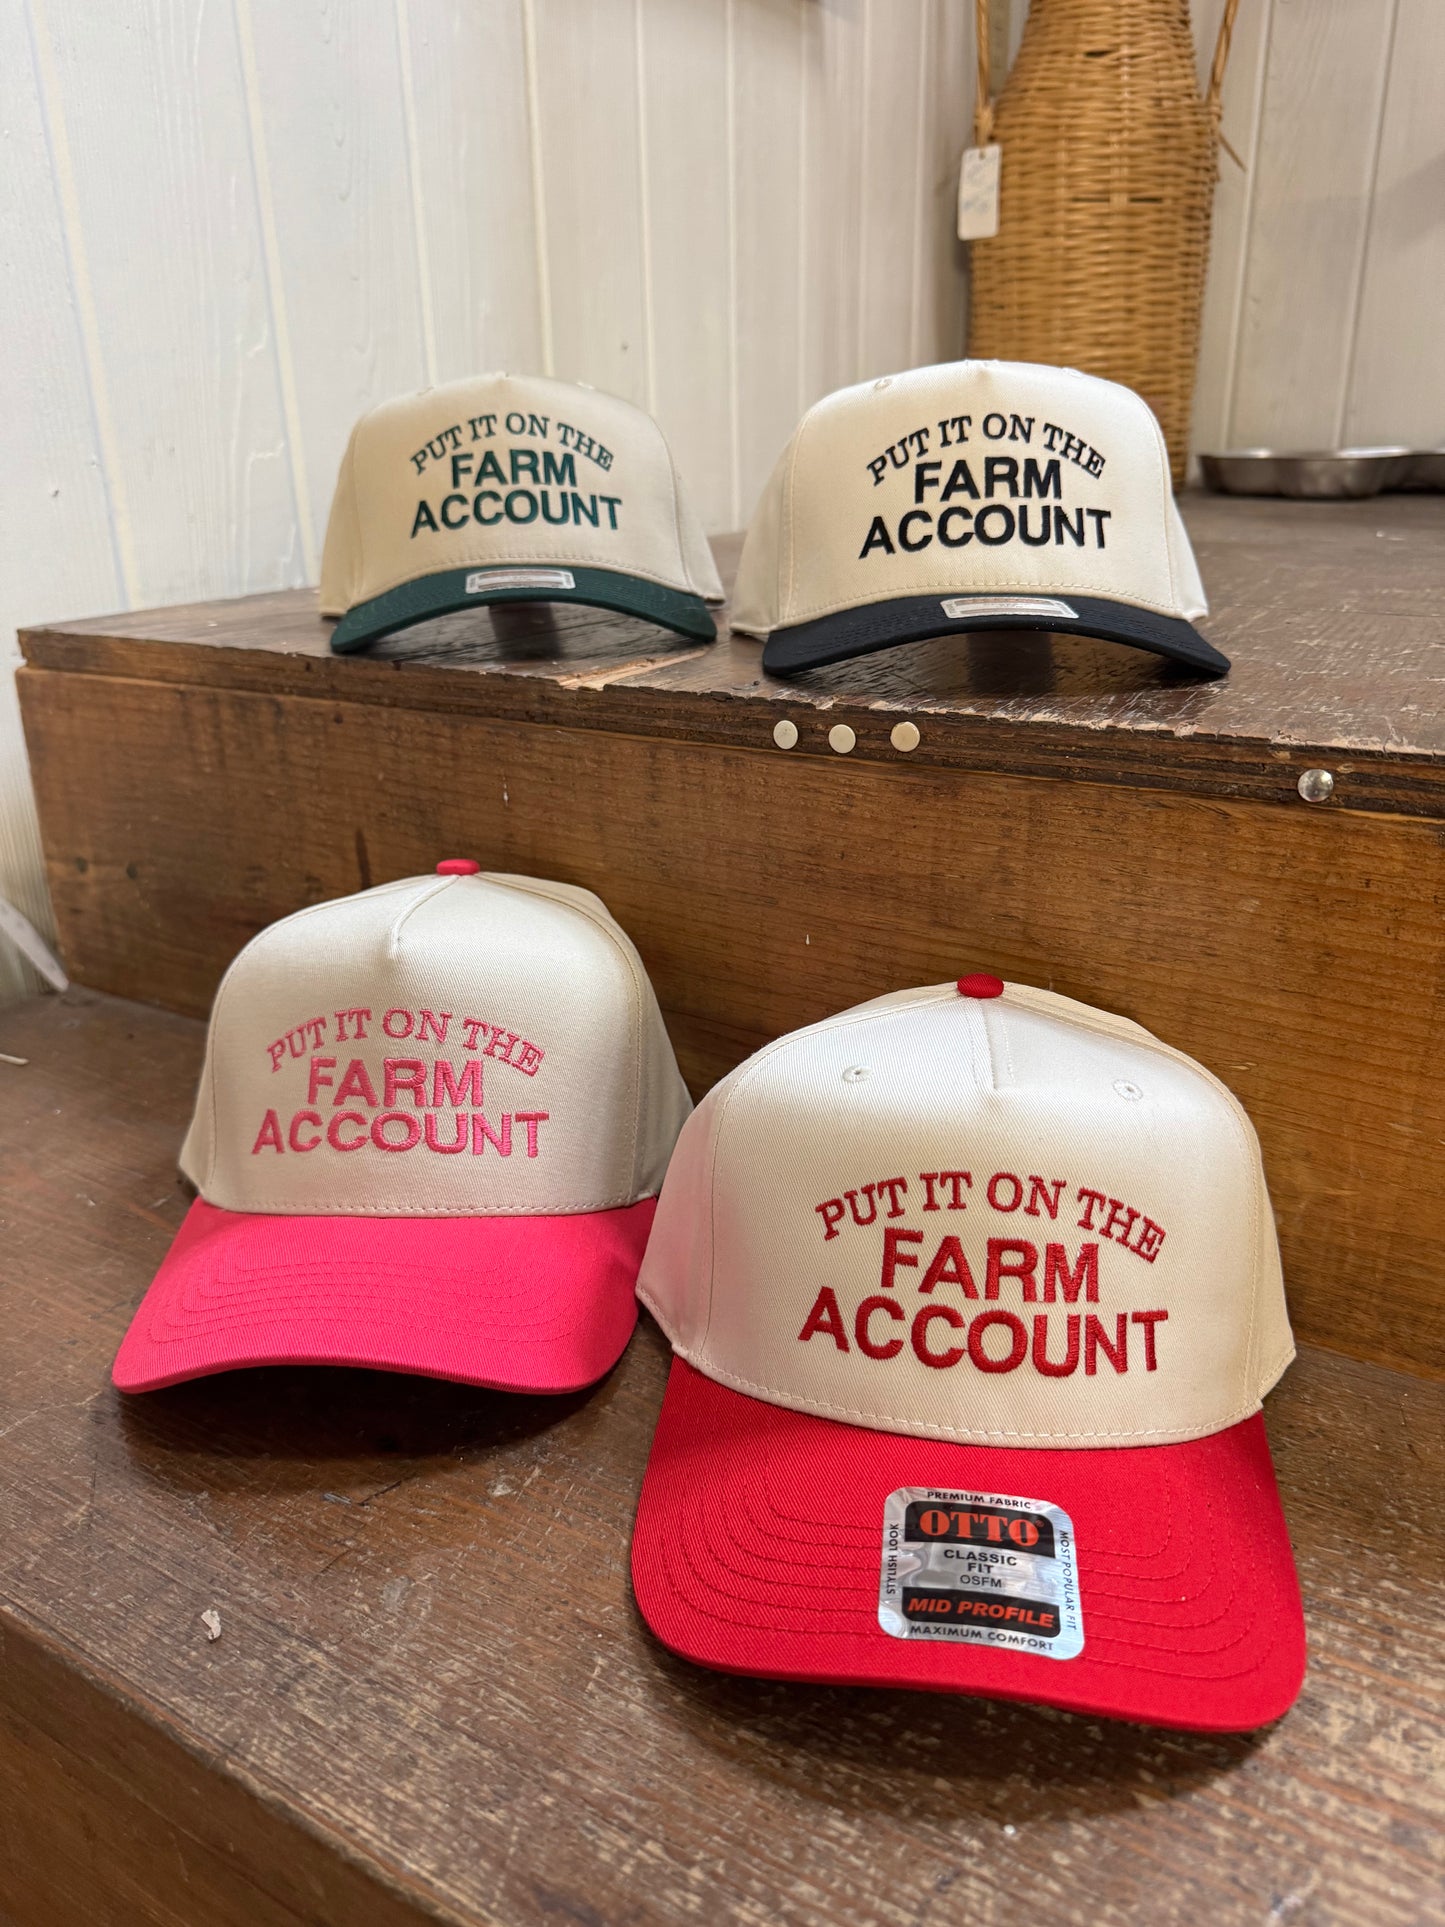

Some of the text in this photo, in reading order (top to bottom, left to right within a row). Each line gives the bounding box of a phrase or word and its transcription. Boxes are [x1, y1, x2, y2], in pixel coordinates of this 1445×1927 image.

[410, 413, 614, 475] PUT IT ON THE
[867, 413, 1106, 486] PUT IT ON THE
[451, 449, 577, 489] FARM
[914, 456, 1062, 503] FARM
[411, 490, 622, 538] ACCOUNT
[858, 504, 1111, 559] ACCOUNT
[267, 1008, 545, 1076] PUT IT ON THE
[308, 1056, 483, 1107] FARM
[252, 1109, 549, 1157] ACCOUNT
[815, 1171, 1166, 1263] PUT IT ON THE
[881, 1227, 1100, 1303] FARM
[798, 1286, 1168, 1378] ACCOUNT
[927, 1491, 1031, 1509] PREMIUM FABRIC
[919, 1510, 1039, 1547] OTTO
[887, 1524, 899, 1594] STYLISH LOOK
[944, 1549, 1017, 1566] CLASSIC
[960, 1575, 1002, 1588] OSFM
[968, 1562, 994, 1574] FIT
[1060, 1530, 1076, 1630] MOST POPULAR FIT
[908, 1597, 1055, 1628] MID PROFILE
[910, 1625, 1053, 1650] MAXIMUM COMFORT
